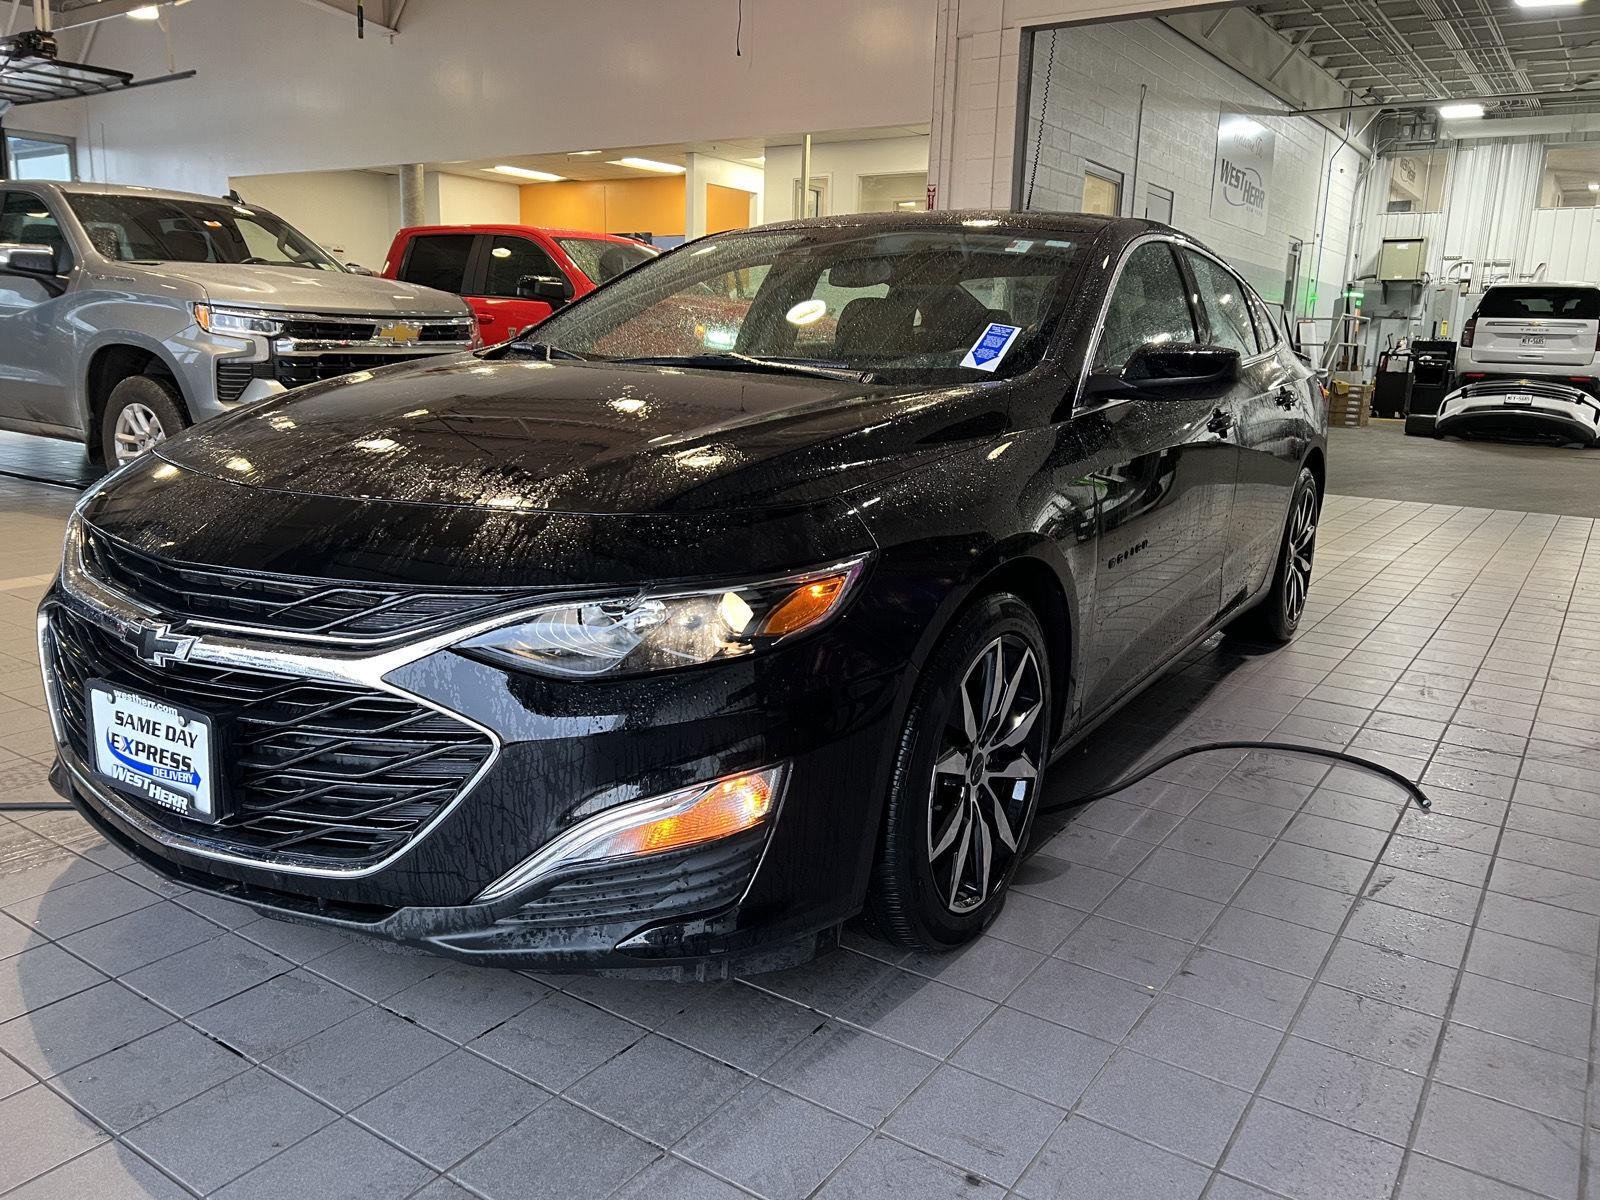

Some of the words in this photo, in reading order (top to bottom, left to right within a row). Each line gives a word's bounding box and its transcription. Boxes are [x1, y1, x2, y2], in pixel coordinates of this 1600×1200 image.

[1220, 158, 1246, 191] WEST
[1242, 179, 1266, 210] HERR
[113, 689, 178, 716] westherr.com
[114, 710, 162, 738] SAME
[165, 724, 198, 749] DAY
[111, 732, 192, 773] EXPRESS
[111, 763, 152, 791] WEST
[148, 783, 188, 810] HERR
[152, 766, 194, 784] DELIVERY
